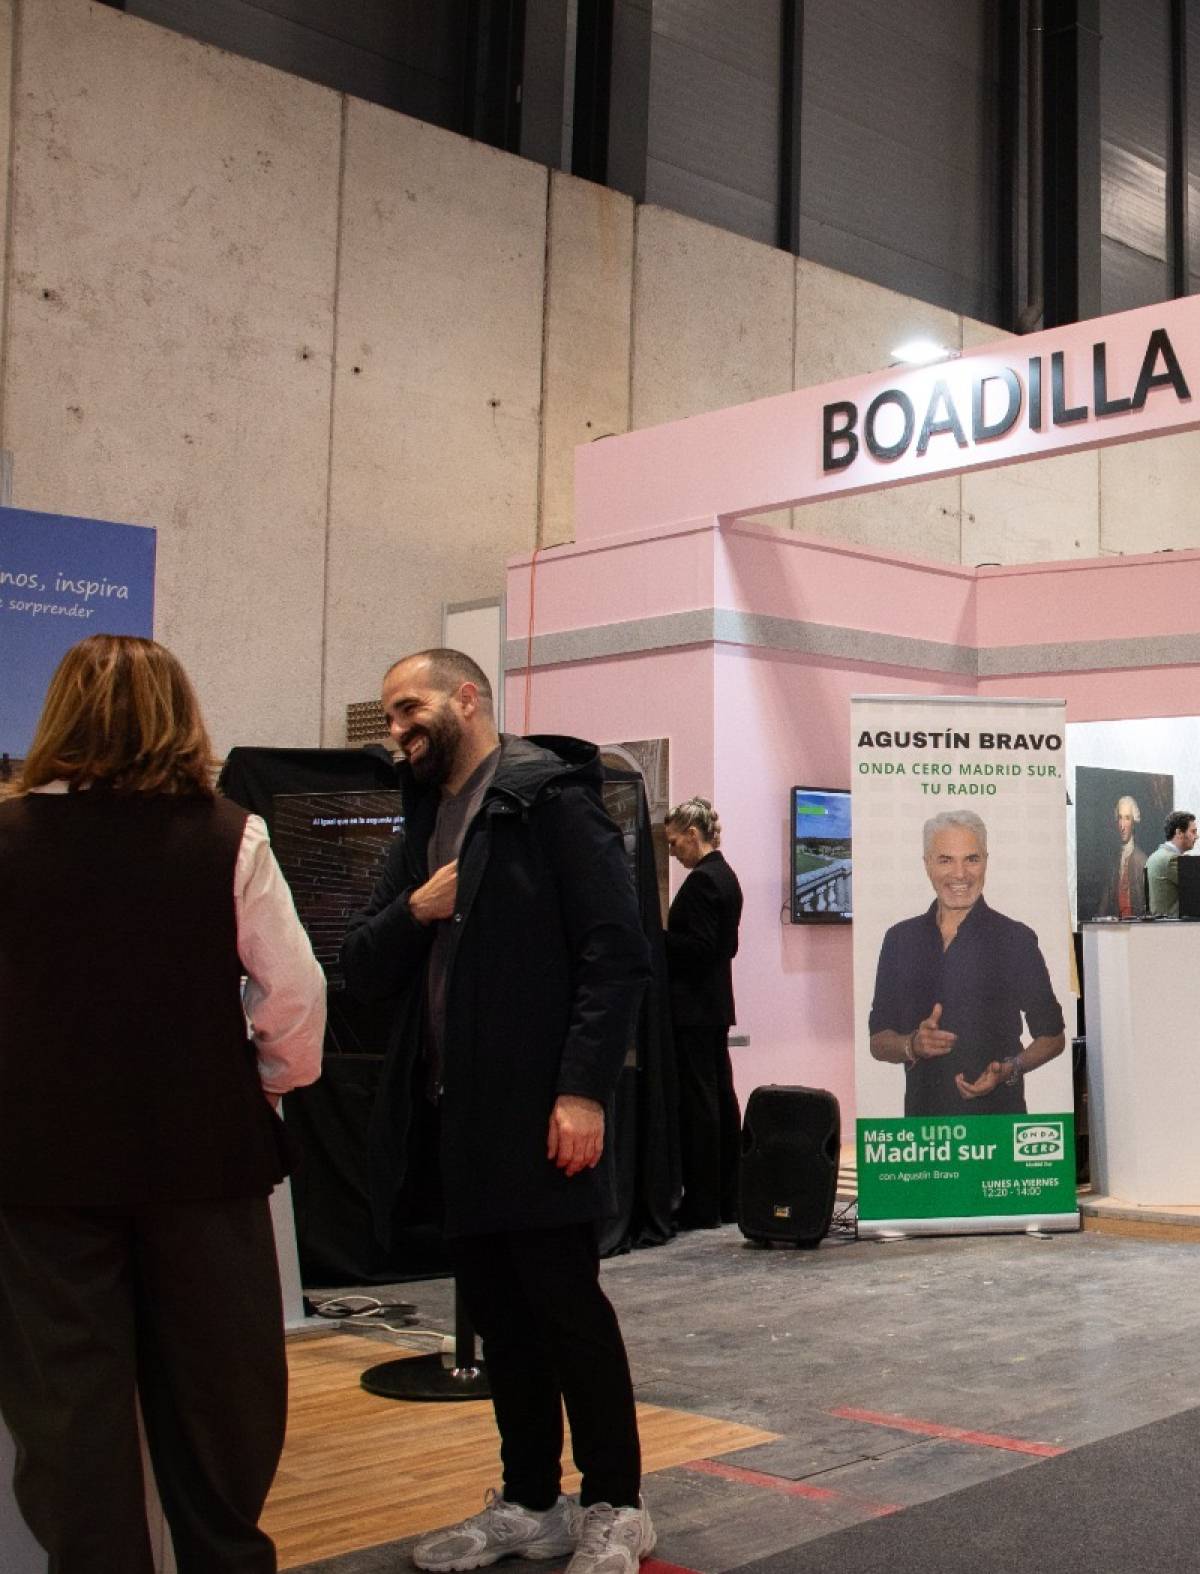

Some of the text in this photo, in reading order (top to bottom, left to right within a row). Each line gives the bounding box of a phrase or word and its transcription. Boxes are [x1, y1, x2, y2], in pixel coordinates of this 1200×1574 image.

[820, 327, 1191, 473] BOADILLA
[55, 572, 128, 601] inspira
[9, 599, 95, 618] sorprender
[857, 728, 1062, 751] AGUSTÍN BRAVO
[859, 762, 906, 775] ONDA
[912, 763, 952, 775] CERO
[959, 763, 1022, 776] MADRID
[921, 783, 997, 795] TU RADIO
[864, 1124, 967, 1143] Más de uno
[1022, 1131, 1055, 1140] ONDA
[864, 1141, 997, 1164] Madrid sur
[1023, 1143, 1056, 1154] CERO
[879, 1173, 897, 1182] con
[934, 1170, 960, 1180] Bravo
[982, 1177, 1060, 1189] LUNES A VIERNES
